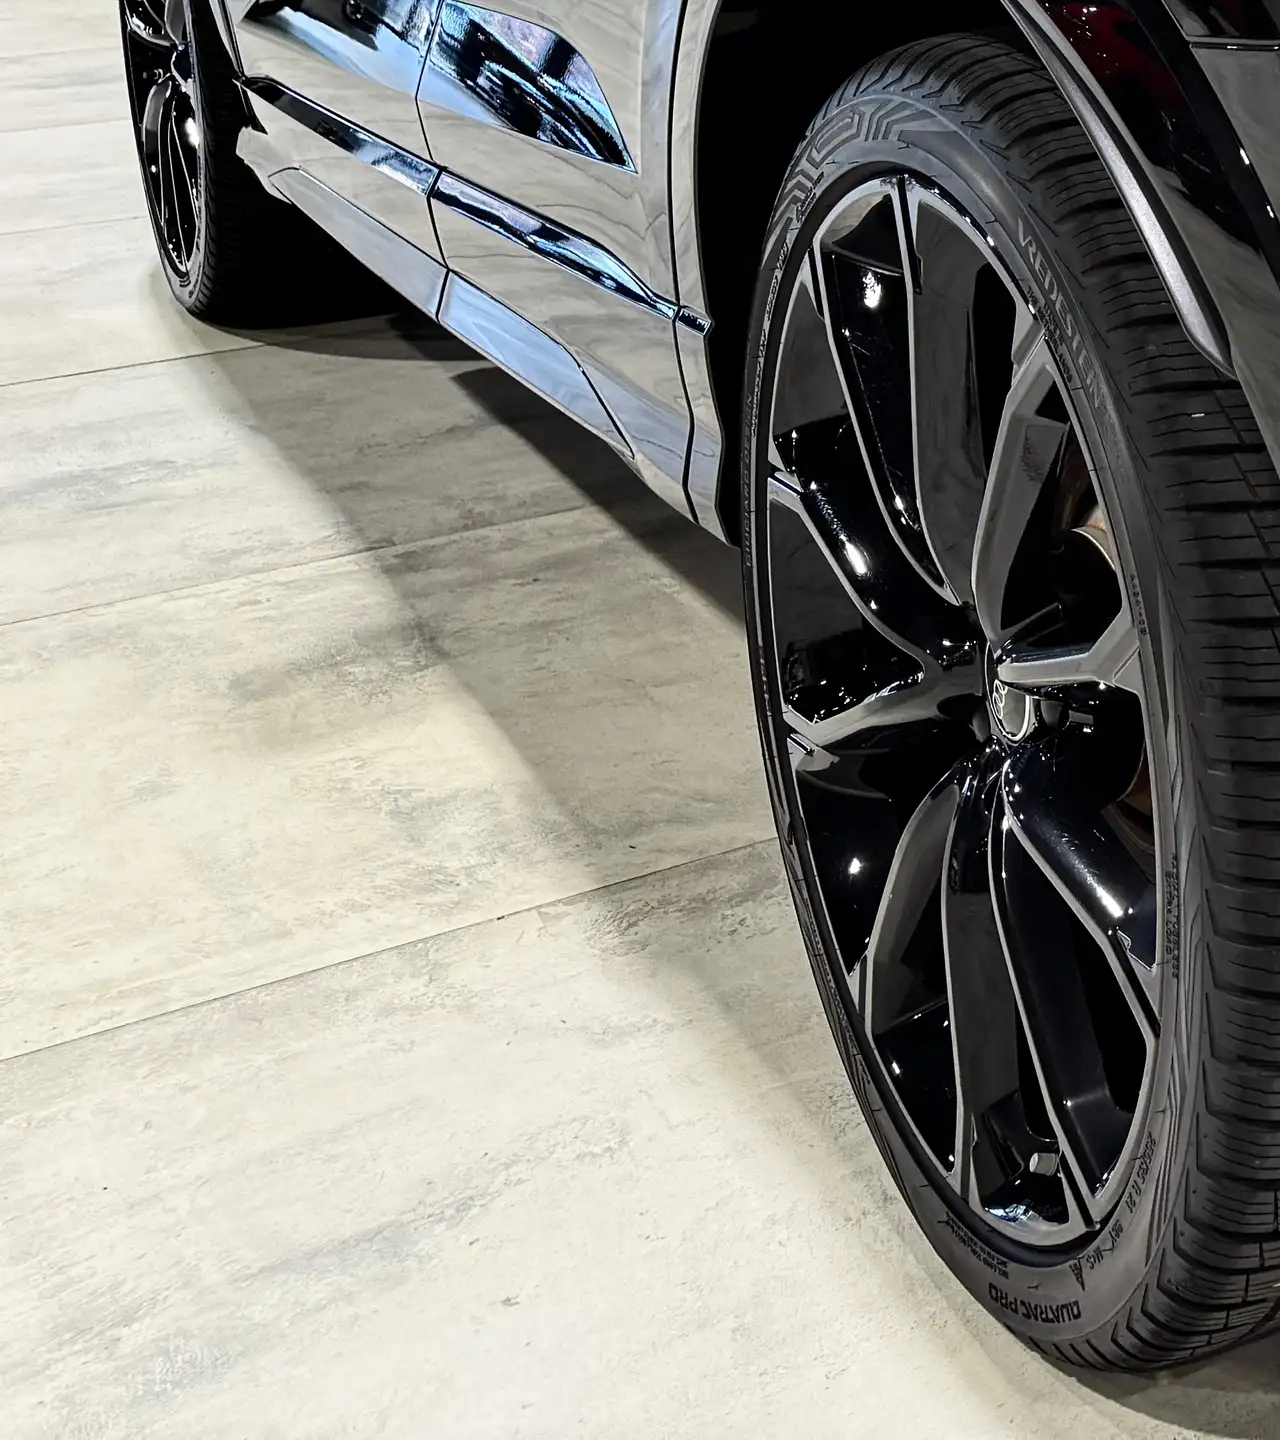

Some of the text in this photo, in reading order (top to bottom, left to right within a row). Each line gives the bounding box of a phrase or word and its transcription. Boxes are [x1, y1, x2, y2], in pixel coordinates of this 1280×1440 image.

[1017, 216, 1101, 409] VREDESTEIN
[988, 1281, 1083, 1324] QUATRAC PRO
